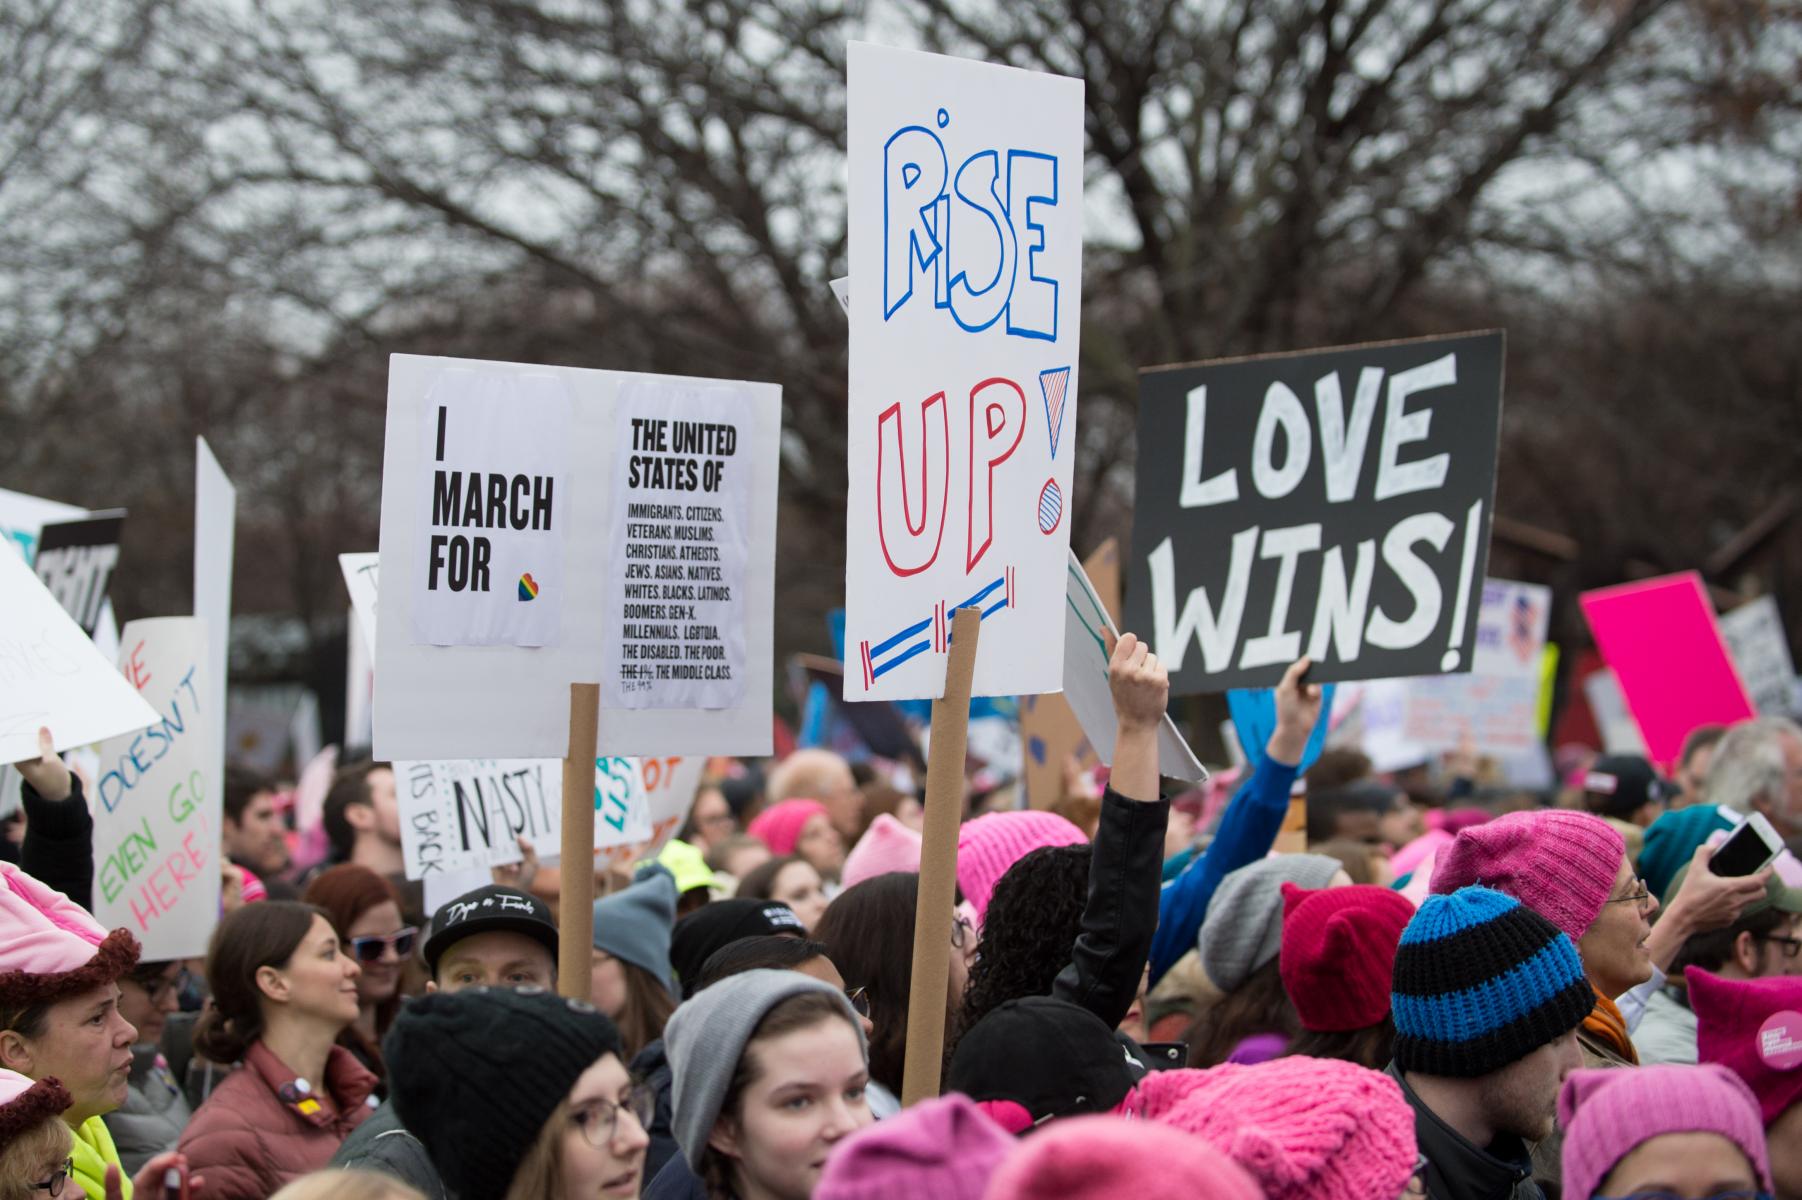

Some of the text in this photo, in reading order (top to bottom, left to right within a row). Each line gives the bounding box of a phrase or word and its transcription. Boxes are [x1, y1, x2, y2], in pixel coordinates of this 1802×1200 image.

[435, 406, 448, 461] I
[631, 418, 737, 456] THE UNITED
[1179, 352, 1458, 509] LOVE
[628, 455, 725, 493] STATES OF
[877, 366, 1072, 577] UP!
[432, 470, 554, 530] MARCH
[627, 503, 725, 522] IMMIGRANTS. CITIZENS.
[626, 523, 715, 542] VETERANS. MUSLIMS.
[428, 535, 491, 592] FOR
[626, 543, 721, 562] CHRISTIANS. ATHEISTS.
[625, 564, 723, 581] JEWS. ASIANS. NATIVES.
[1148, 498, 1482, 674] WINS!
[624, 584, 733, 602] WHITES. BLACKS. LATINOS.
[623, 604, 697, 621] BOOMERS. GEN-X.
[622, 623, 721, 641] MILLENNIALS. LGBTQIA.
[622, 644, 727, 661] THE DISABLED. THE POOR.
[655, 664, 671, 680] THE
[671, 664, 704, 681] MIDDLE
[704, 665, 732, 681] CLASS.
[98, 666, 199, 814] DOESN'T
[452, 764, 551, 852] NASTY
[100, 769, 206, 904] EVEN GO
[411, 809, 444, 877] BACK
